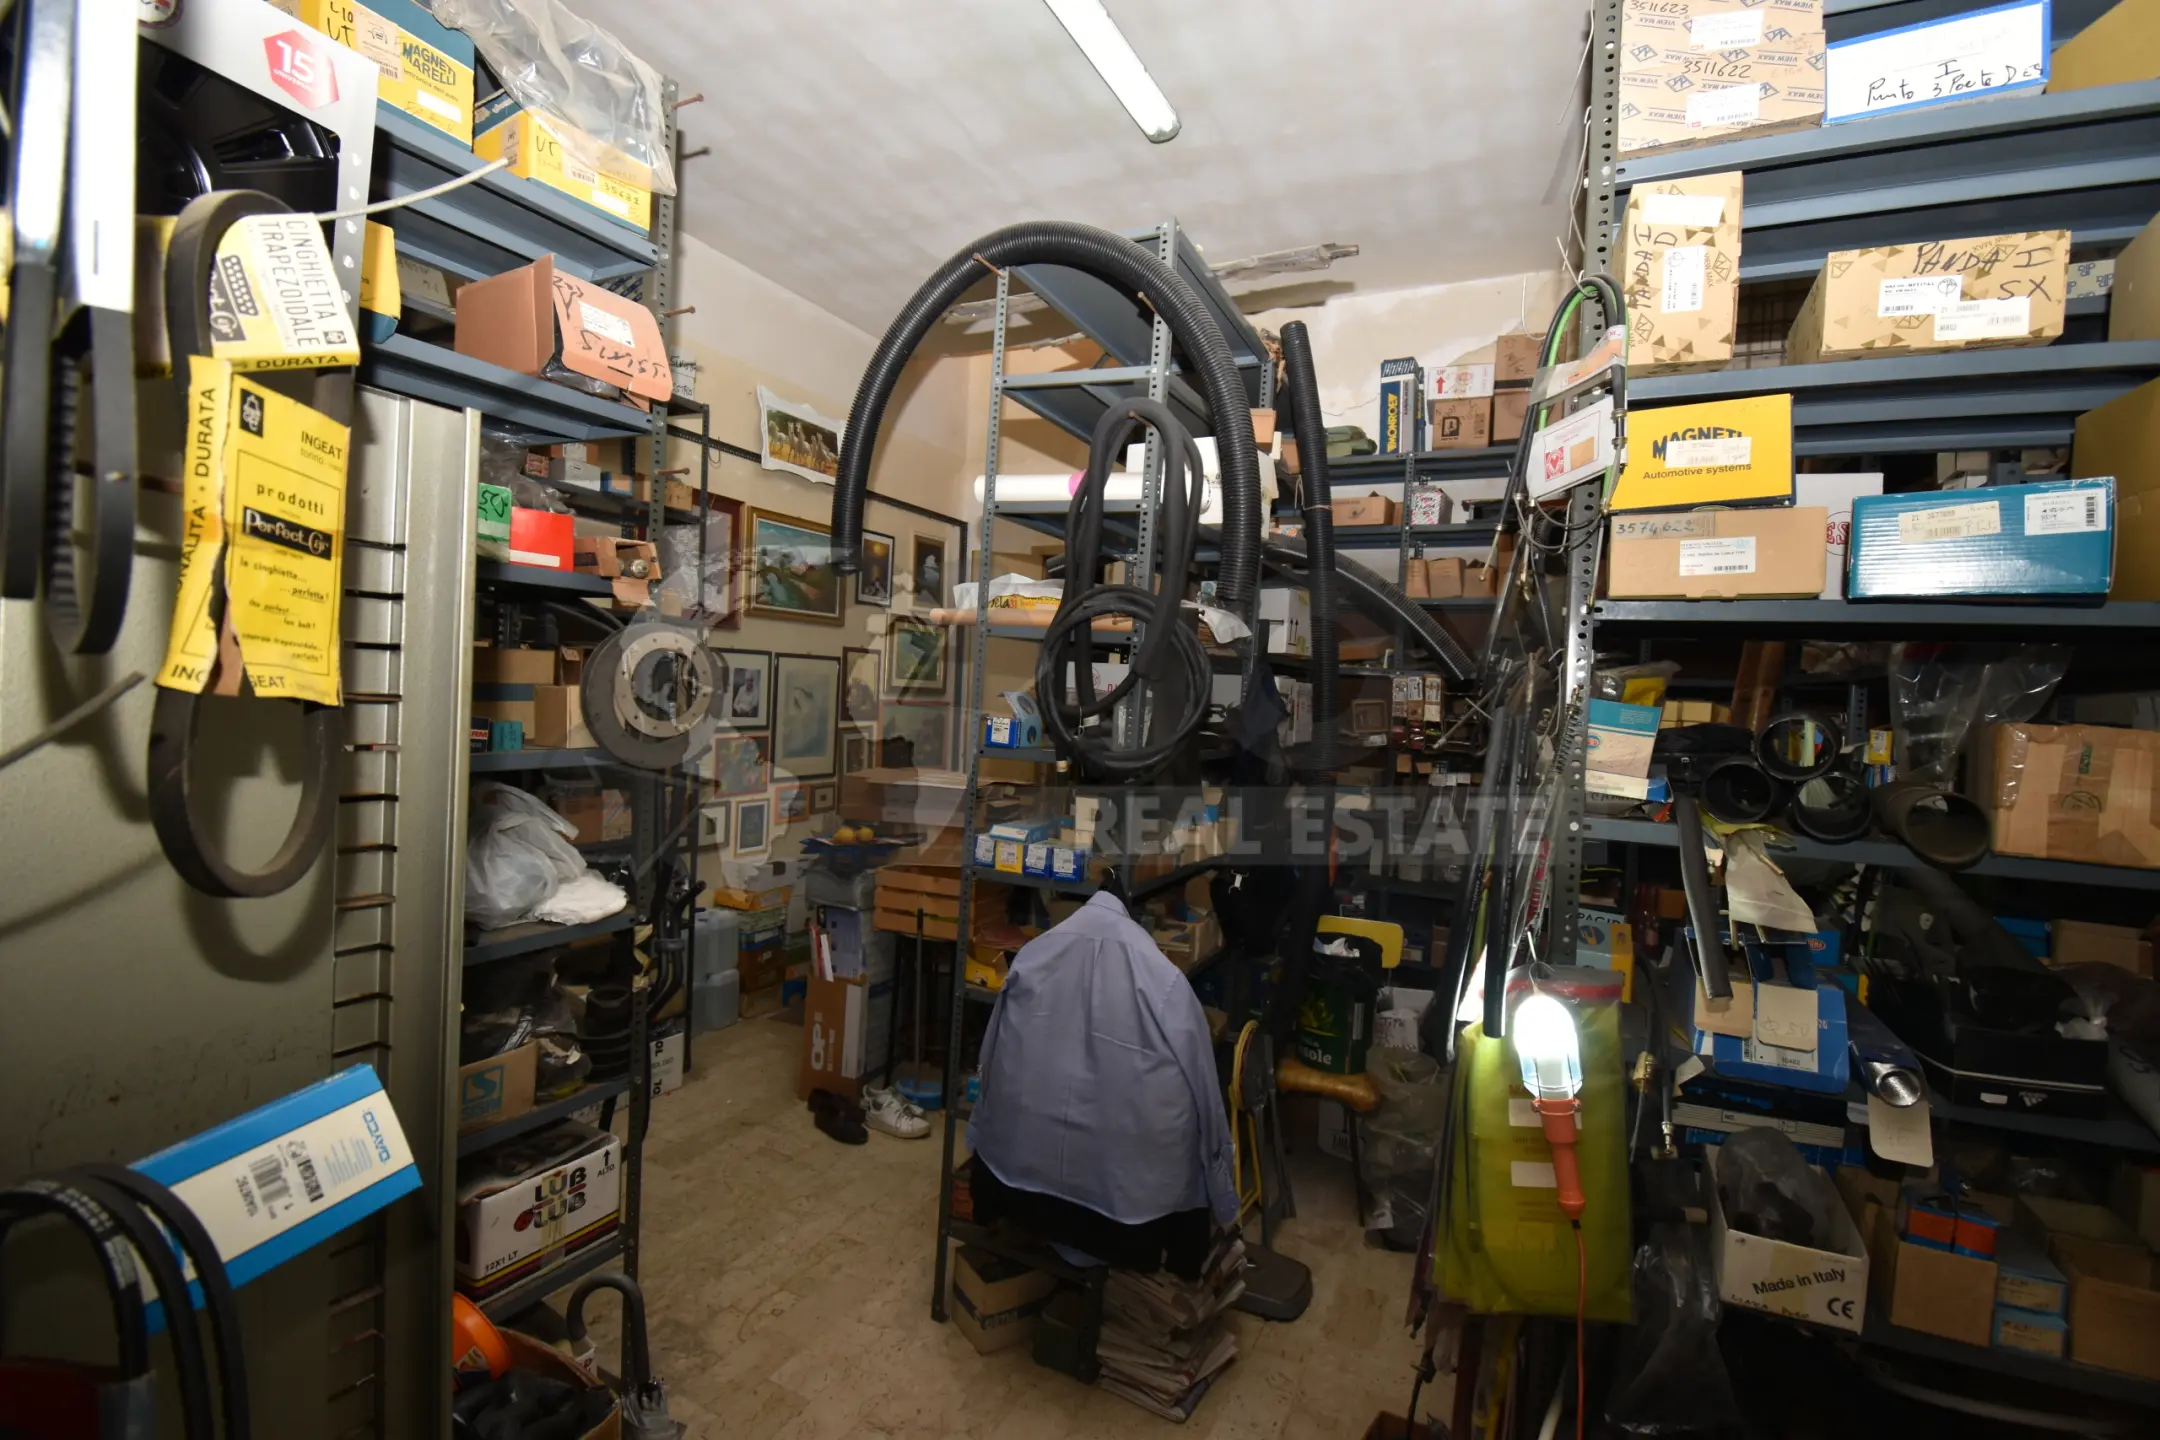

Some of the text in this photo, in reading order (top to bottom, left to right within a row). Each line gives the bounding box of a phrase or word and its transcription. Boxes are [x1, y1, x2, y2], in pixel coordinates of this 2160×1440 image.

[276, 40, 315, 84] 15
[1682, 61, 1752, 78] 3511622
[1932, 82, 1942, 97] 3
[285, 220, 338, 320] CINGHIETTA
[1913, 240, 2000, 275] PANDA
[258, 221, 321, 347] TRAPEZOIDALE
[255, 355, 340, 369] DURATA
[195, 387, 216, 478] DURATA
[1387, 391, 1398, 453] MONROE
[301, 430, 343, 460] INGEAT
[1643, 463, 1752, 480] Automotive systems
[256, 483, 325, 516] prodotti
[362, 1110, 391, 1164] DAYCO
[597, 1163, 615, 1178] ALTO
[1752, 1267, 1846, 1295] Made in Italy
